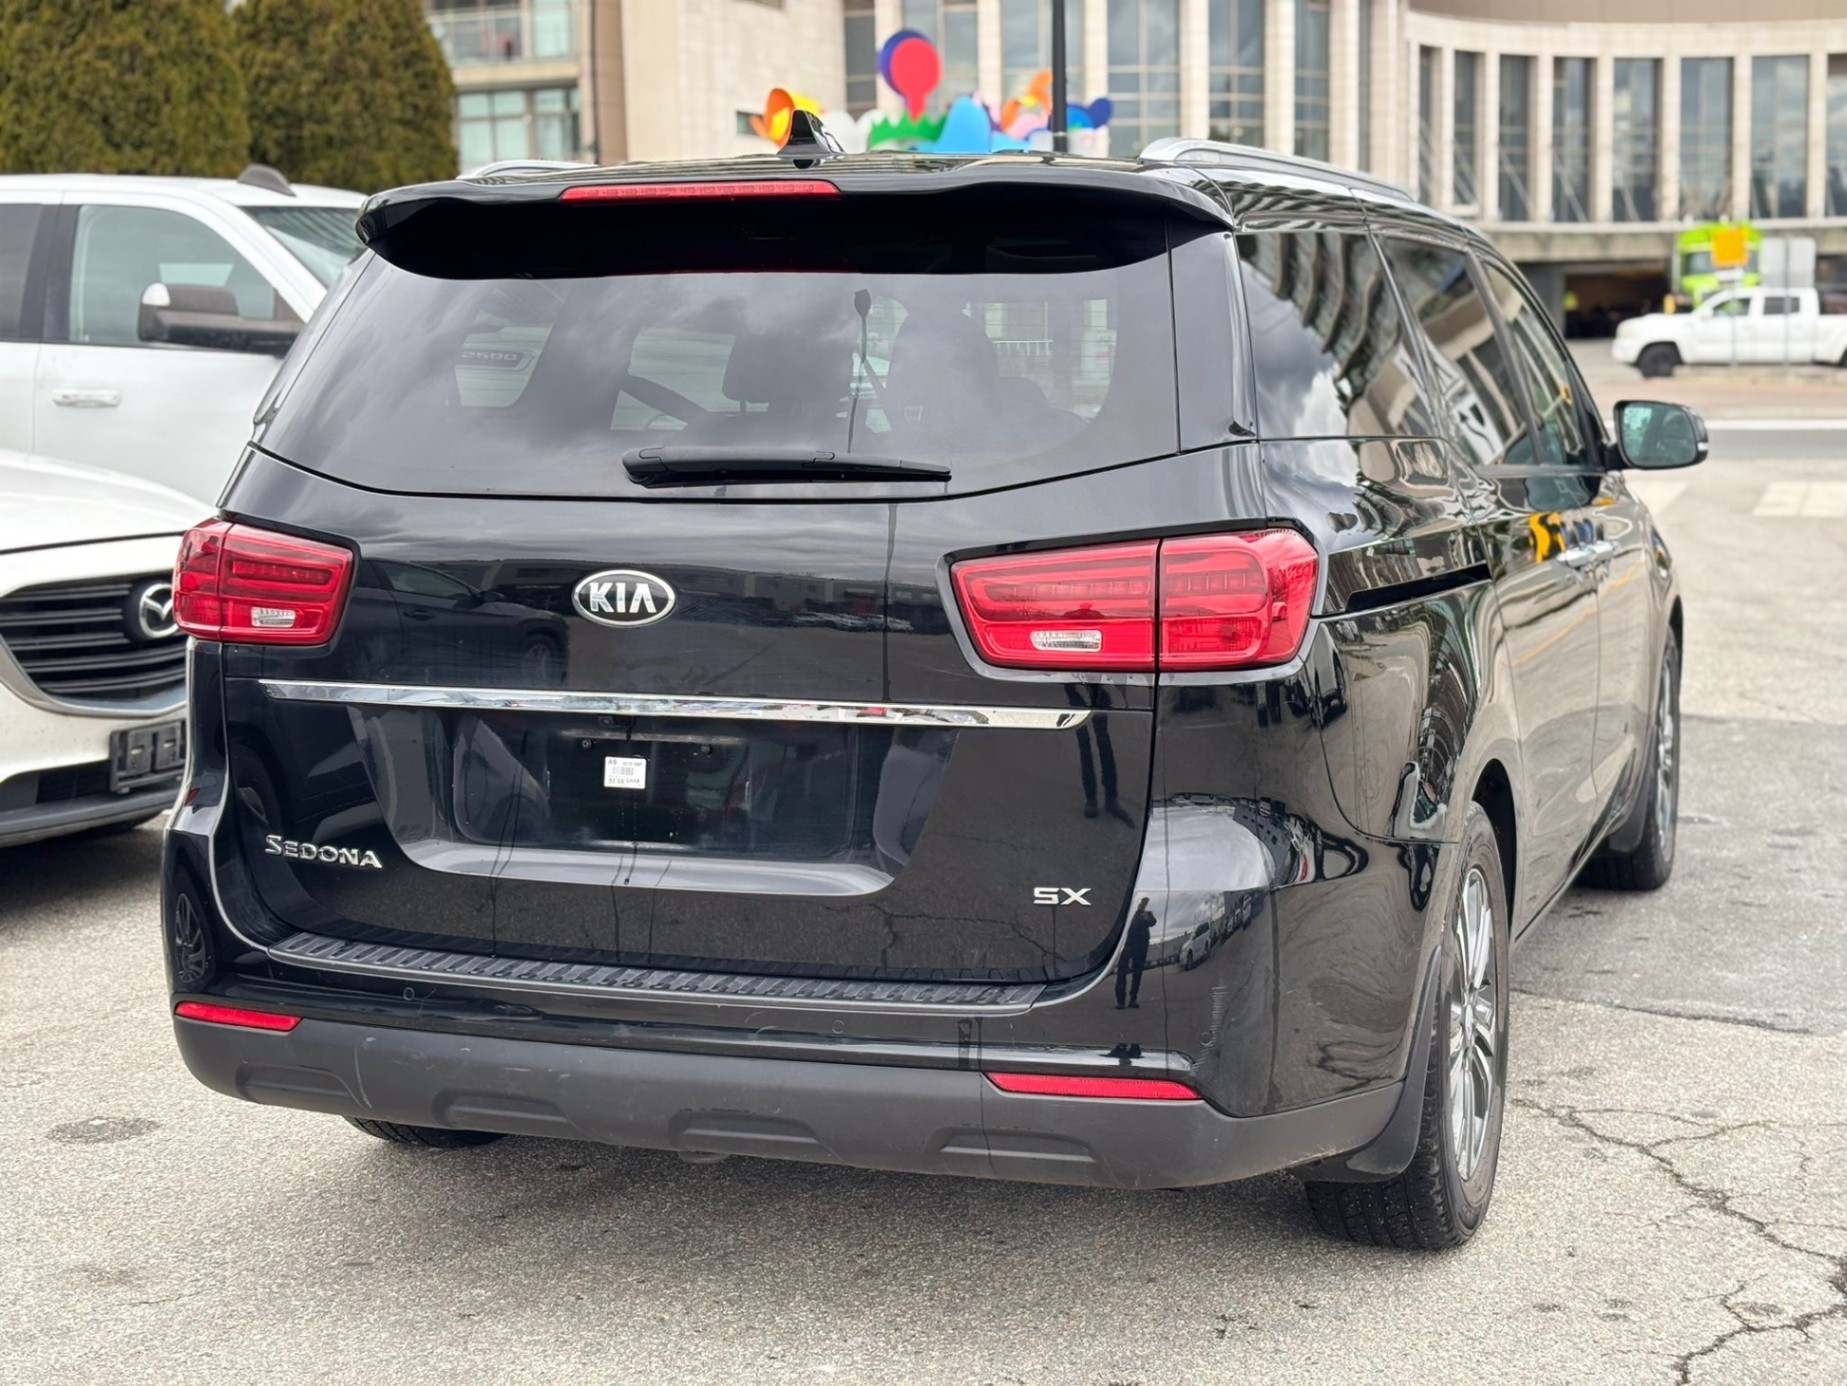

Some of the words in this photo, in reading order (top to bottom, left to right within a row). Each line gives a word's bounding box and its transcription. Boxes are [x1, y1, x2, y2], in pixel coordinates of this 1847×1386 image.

[589, 582, 657, 613] KIA
[265, 834, 383, 869] SEDONA
[1033, 886, 1092, 906] SX
